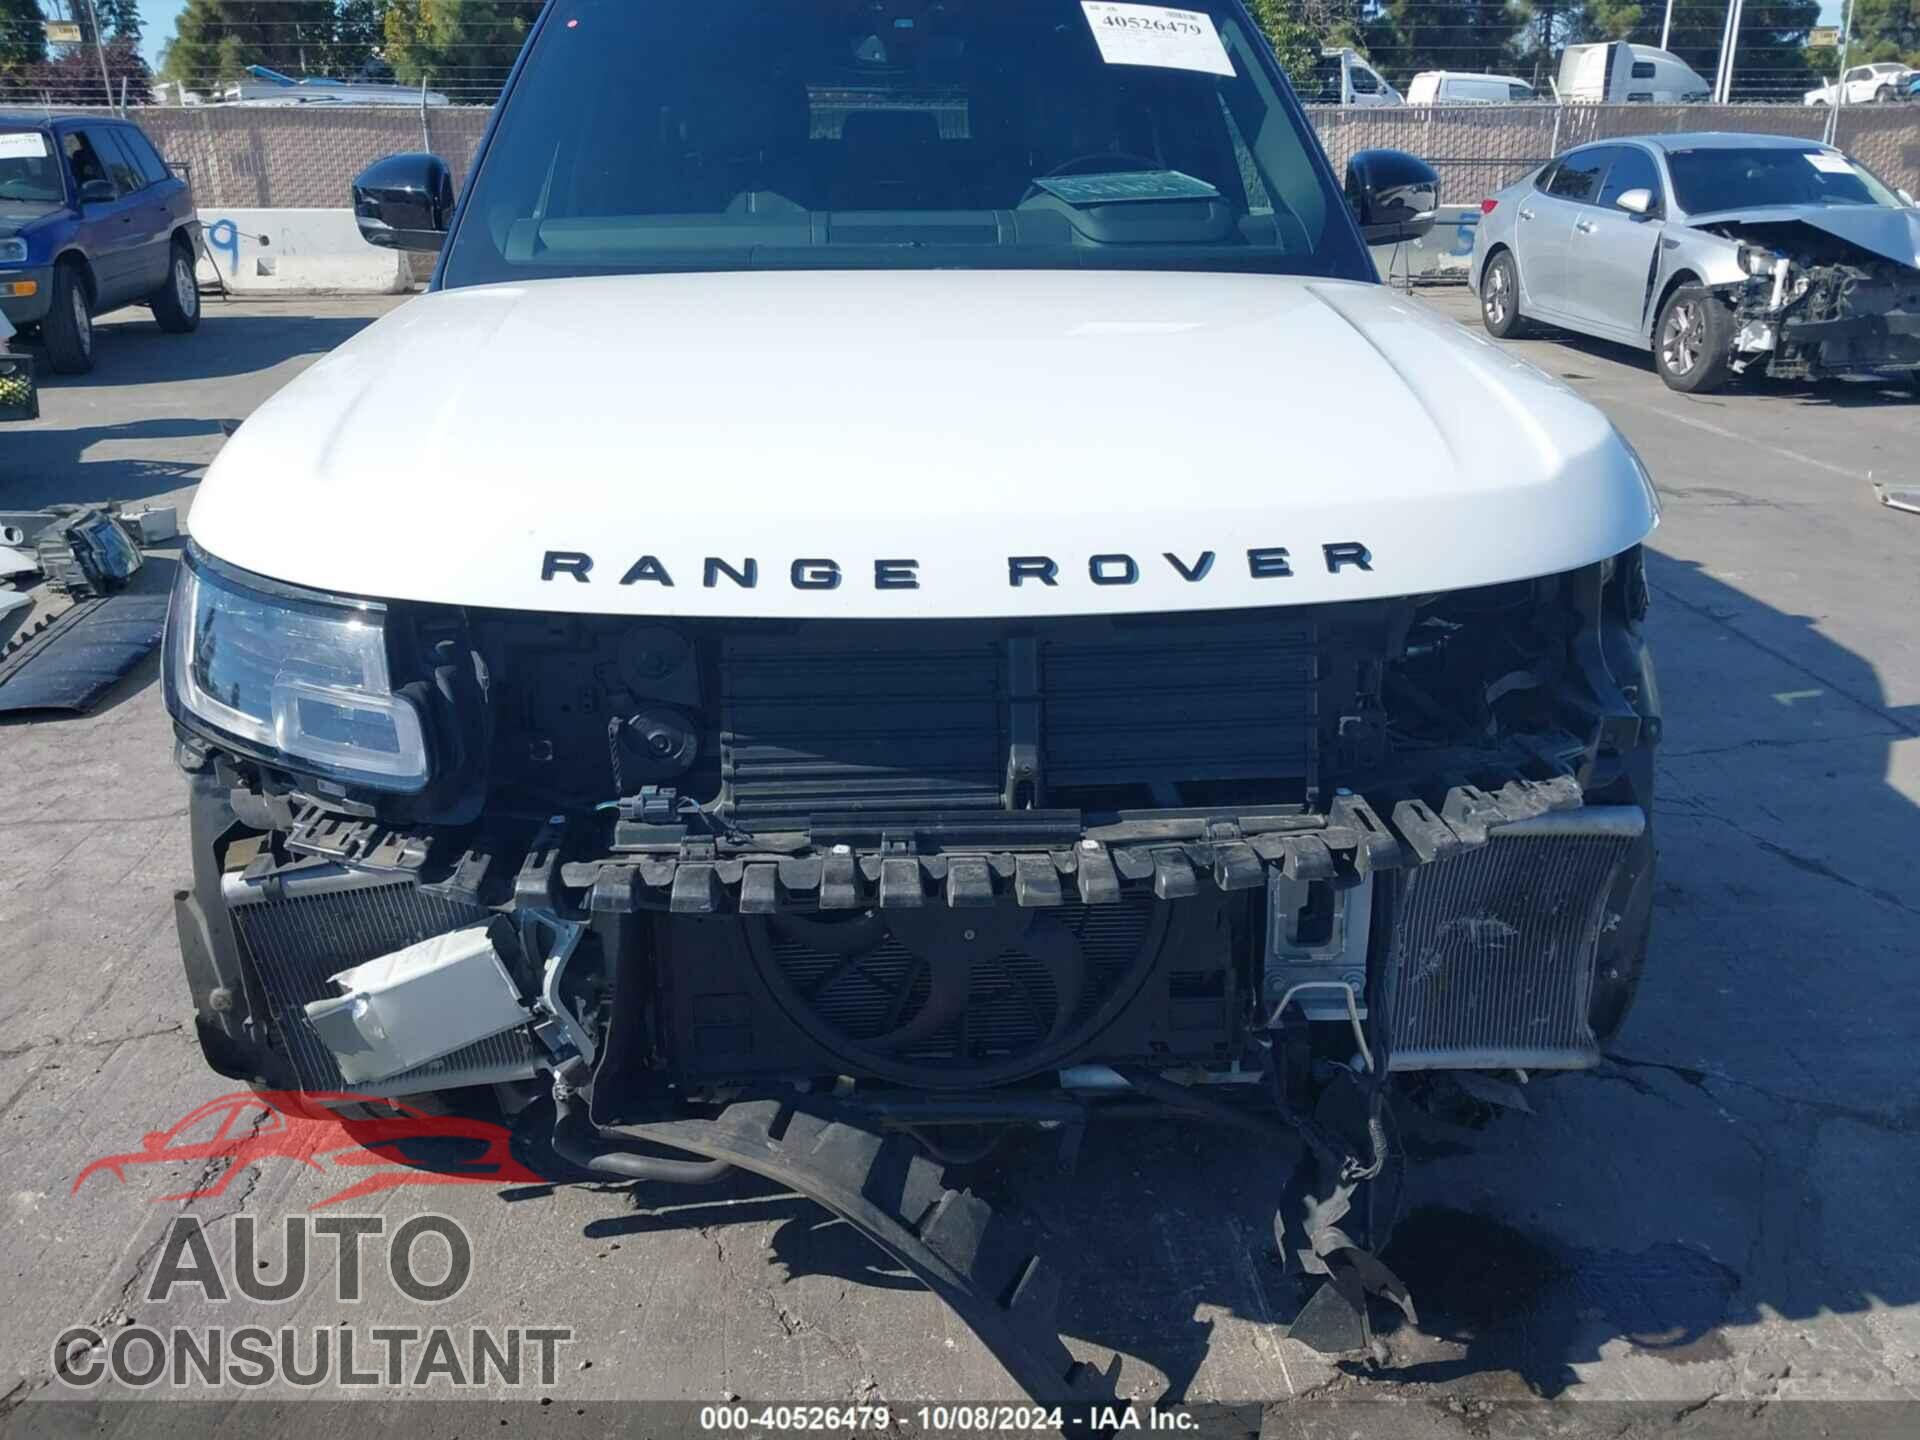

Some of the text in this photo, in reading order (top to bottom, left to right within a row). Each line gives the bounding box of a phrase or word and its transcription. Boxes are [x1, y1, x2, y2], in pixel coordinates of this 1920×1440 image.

[1102, 14, 1203, 36] 40526479
[541, 541, 1374, 589] RANGE ROVER
